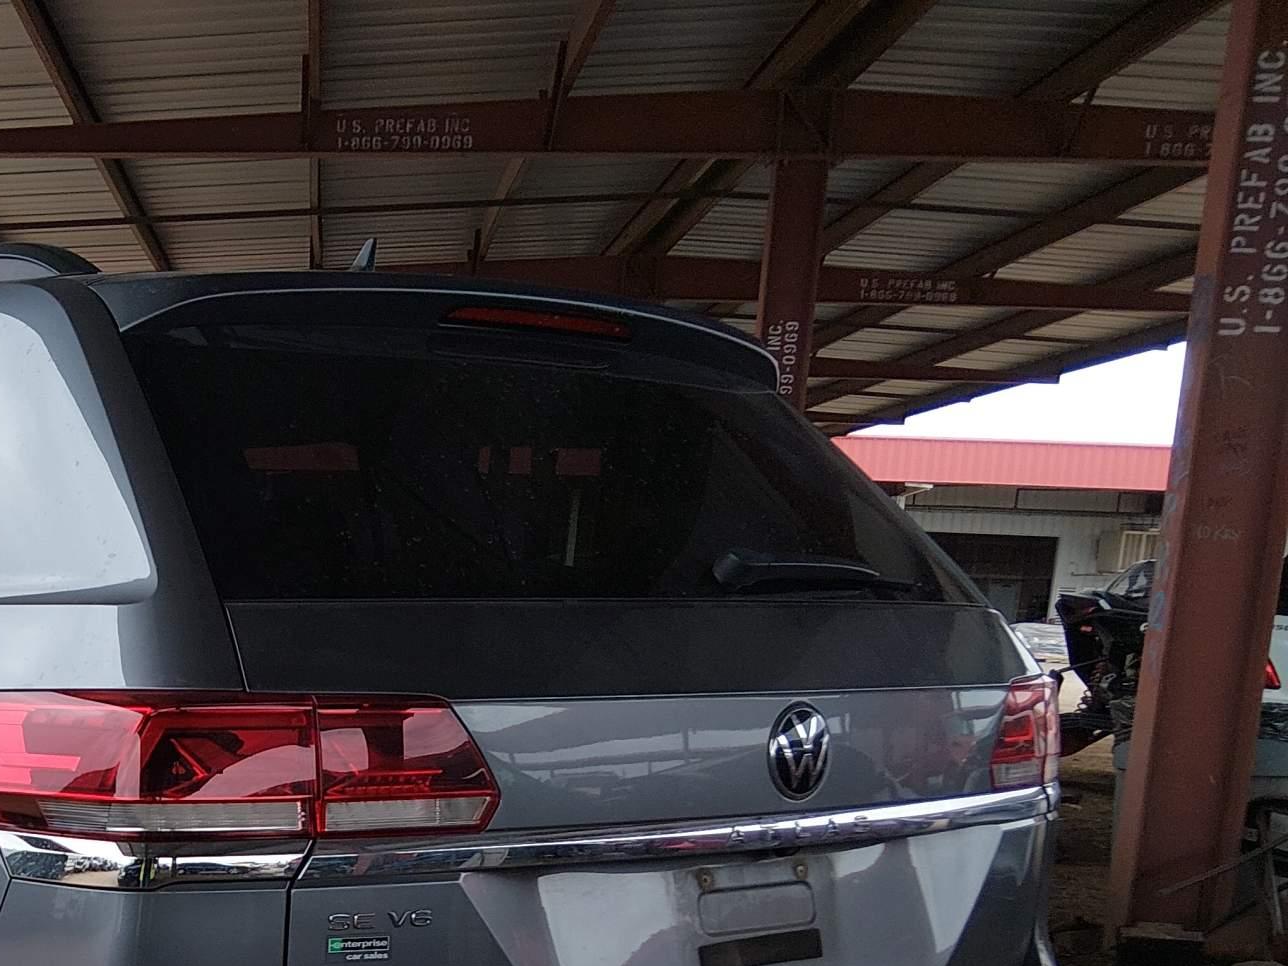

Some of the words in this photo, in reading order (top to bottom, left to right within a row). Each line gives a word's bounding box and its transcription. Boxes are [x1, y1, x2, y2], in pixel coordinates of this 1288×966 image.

[1252, 39, 1288, 103] INC.
[375, 118, 437, 133] PREFAB
[337, 135, 473, 149] 1-866-799-0969
[1230, 122, 1276, 255] PREFAB
[1217, 273, 1254, 336] U.S.
[766, 320, 784, 351] INC.
[328, 913, 376, 931] SE
[388, 910, 433, 928] V6
[332, 939, 388, 949] enterprise
[346, 953, 362, 961] car
[363, 952, 388, 960] sales
